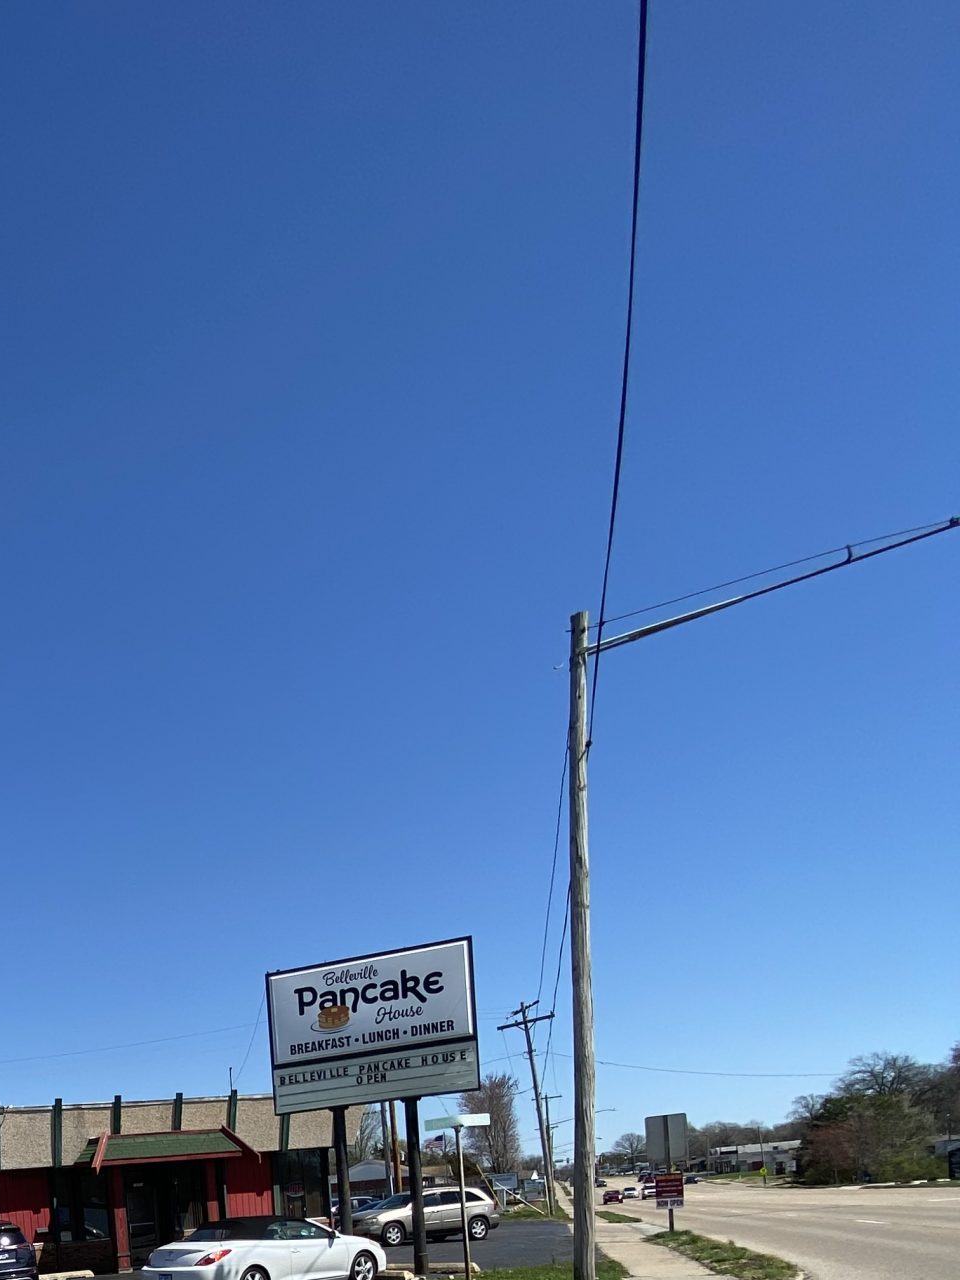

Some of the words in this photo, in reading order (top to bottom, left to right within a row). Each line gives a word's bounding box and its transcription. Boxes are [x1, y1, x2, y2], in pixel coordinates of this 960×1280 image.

[322, 964, 379, 987] Belleville
[293, 969, 445, 1016] Pancake
[375, 1005, 424, 1025] House
[290, 1035, 352, 1056] BREAKFAST
[362, 1028, 400, 1045] LUNCH
[410, 1019, 455, 1037] DINNER
[279, 1066, 349, 1086] BELLEVILLE
[358, 1058, 411, 1075] PANCAKE
[421, 1050, 467, 1066] HOUSE
[356, 1072, 387, 1085] OPEN
